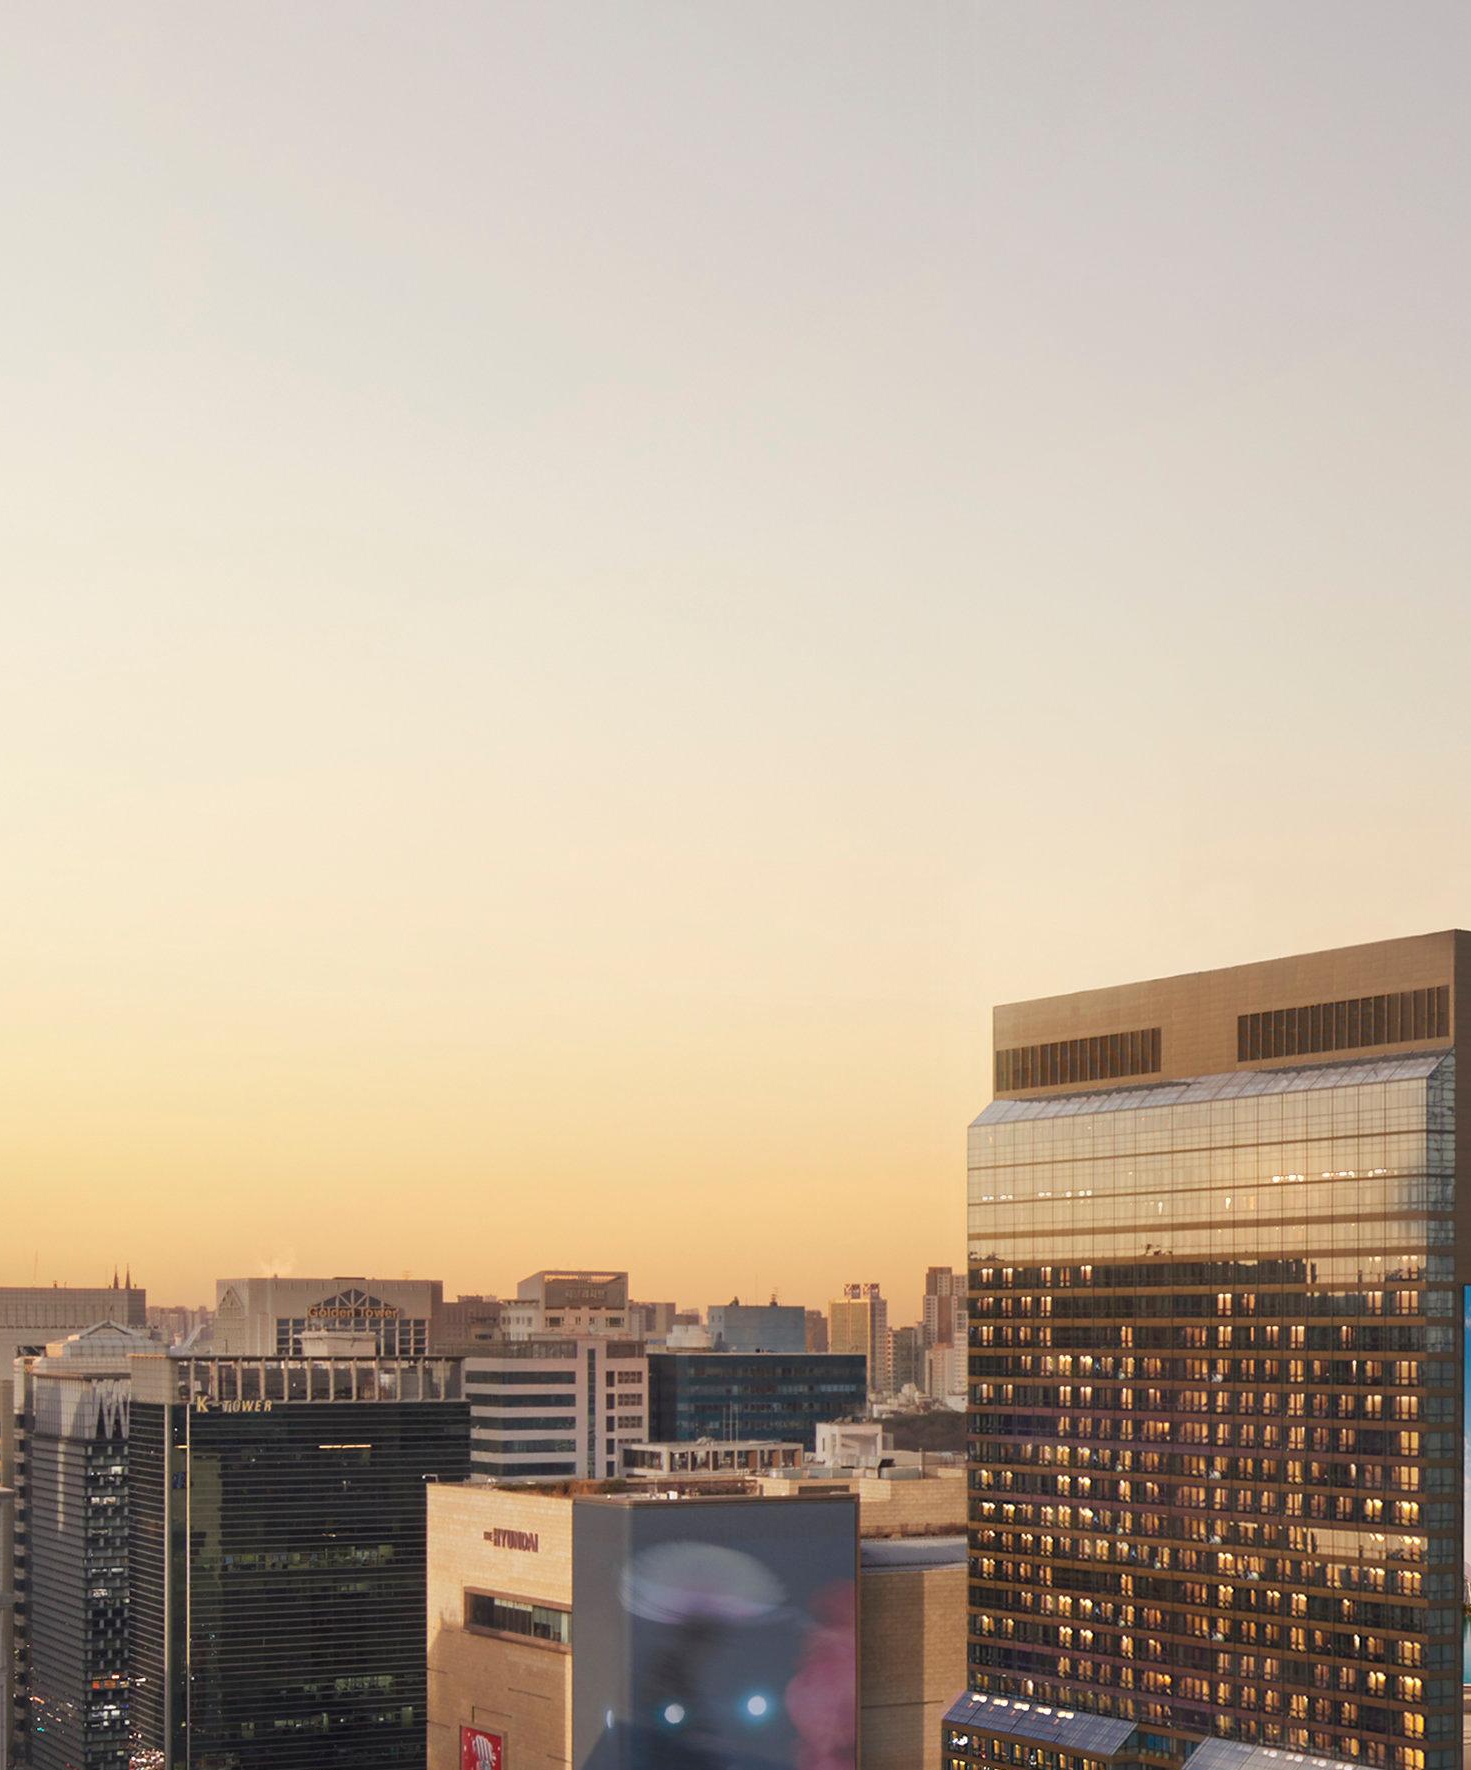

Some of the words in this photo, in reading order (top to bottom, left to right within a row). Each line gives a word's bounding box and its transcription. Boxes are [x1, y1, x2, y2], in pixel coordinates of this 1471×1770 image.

[310, 1308, 353, 1319] Golden
[360, 1308, 399, 1318] Tower
[494, 1527, 539, 1553] HYUNDAI
